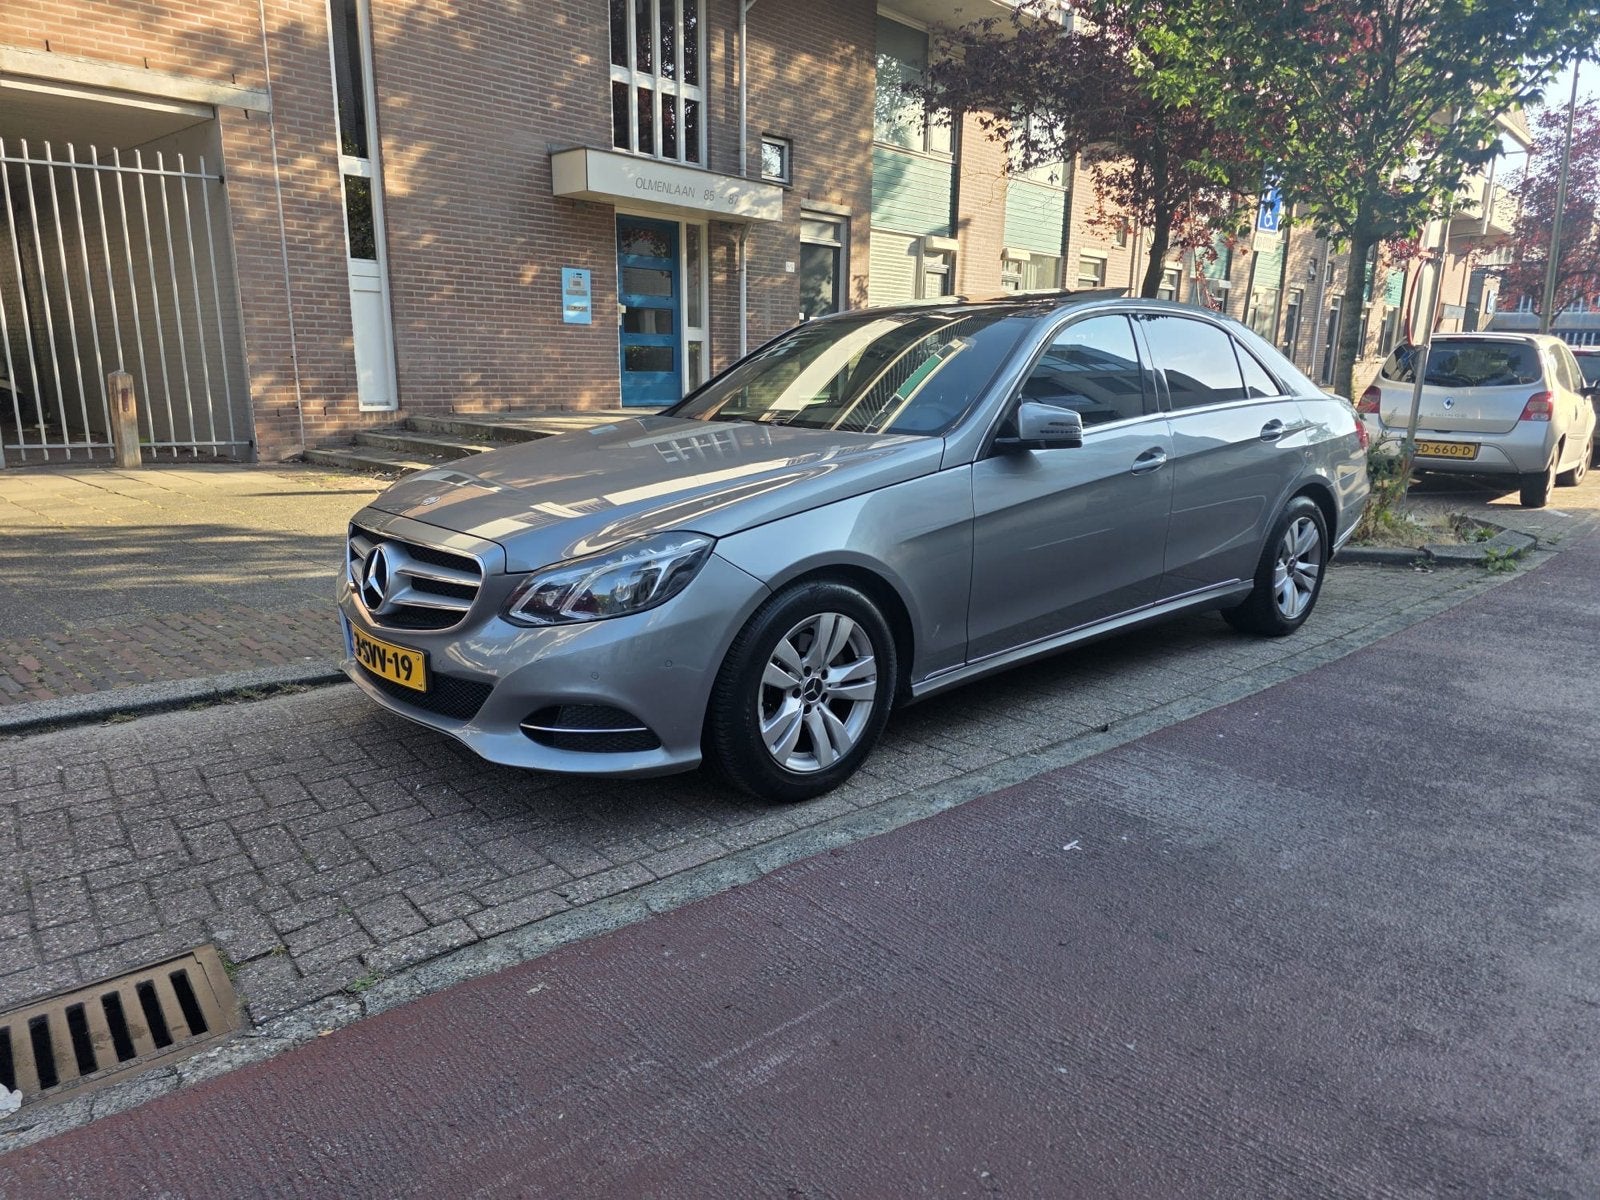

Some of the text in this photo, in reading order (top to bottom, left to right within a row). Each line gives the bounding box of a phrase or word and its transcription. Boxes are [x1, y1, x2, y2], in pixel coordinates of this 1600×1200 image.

[635, 177, 696, 198] OLMENLAAN
[703, 189, 715, 202] 85
[728, 193, 740, 206] 87
